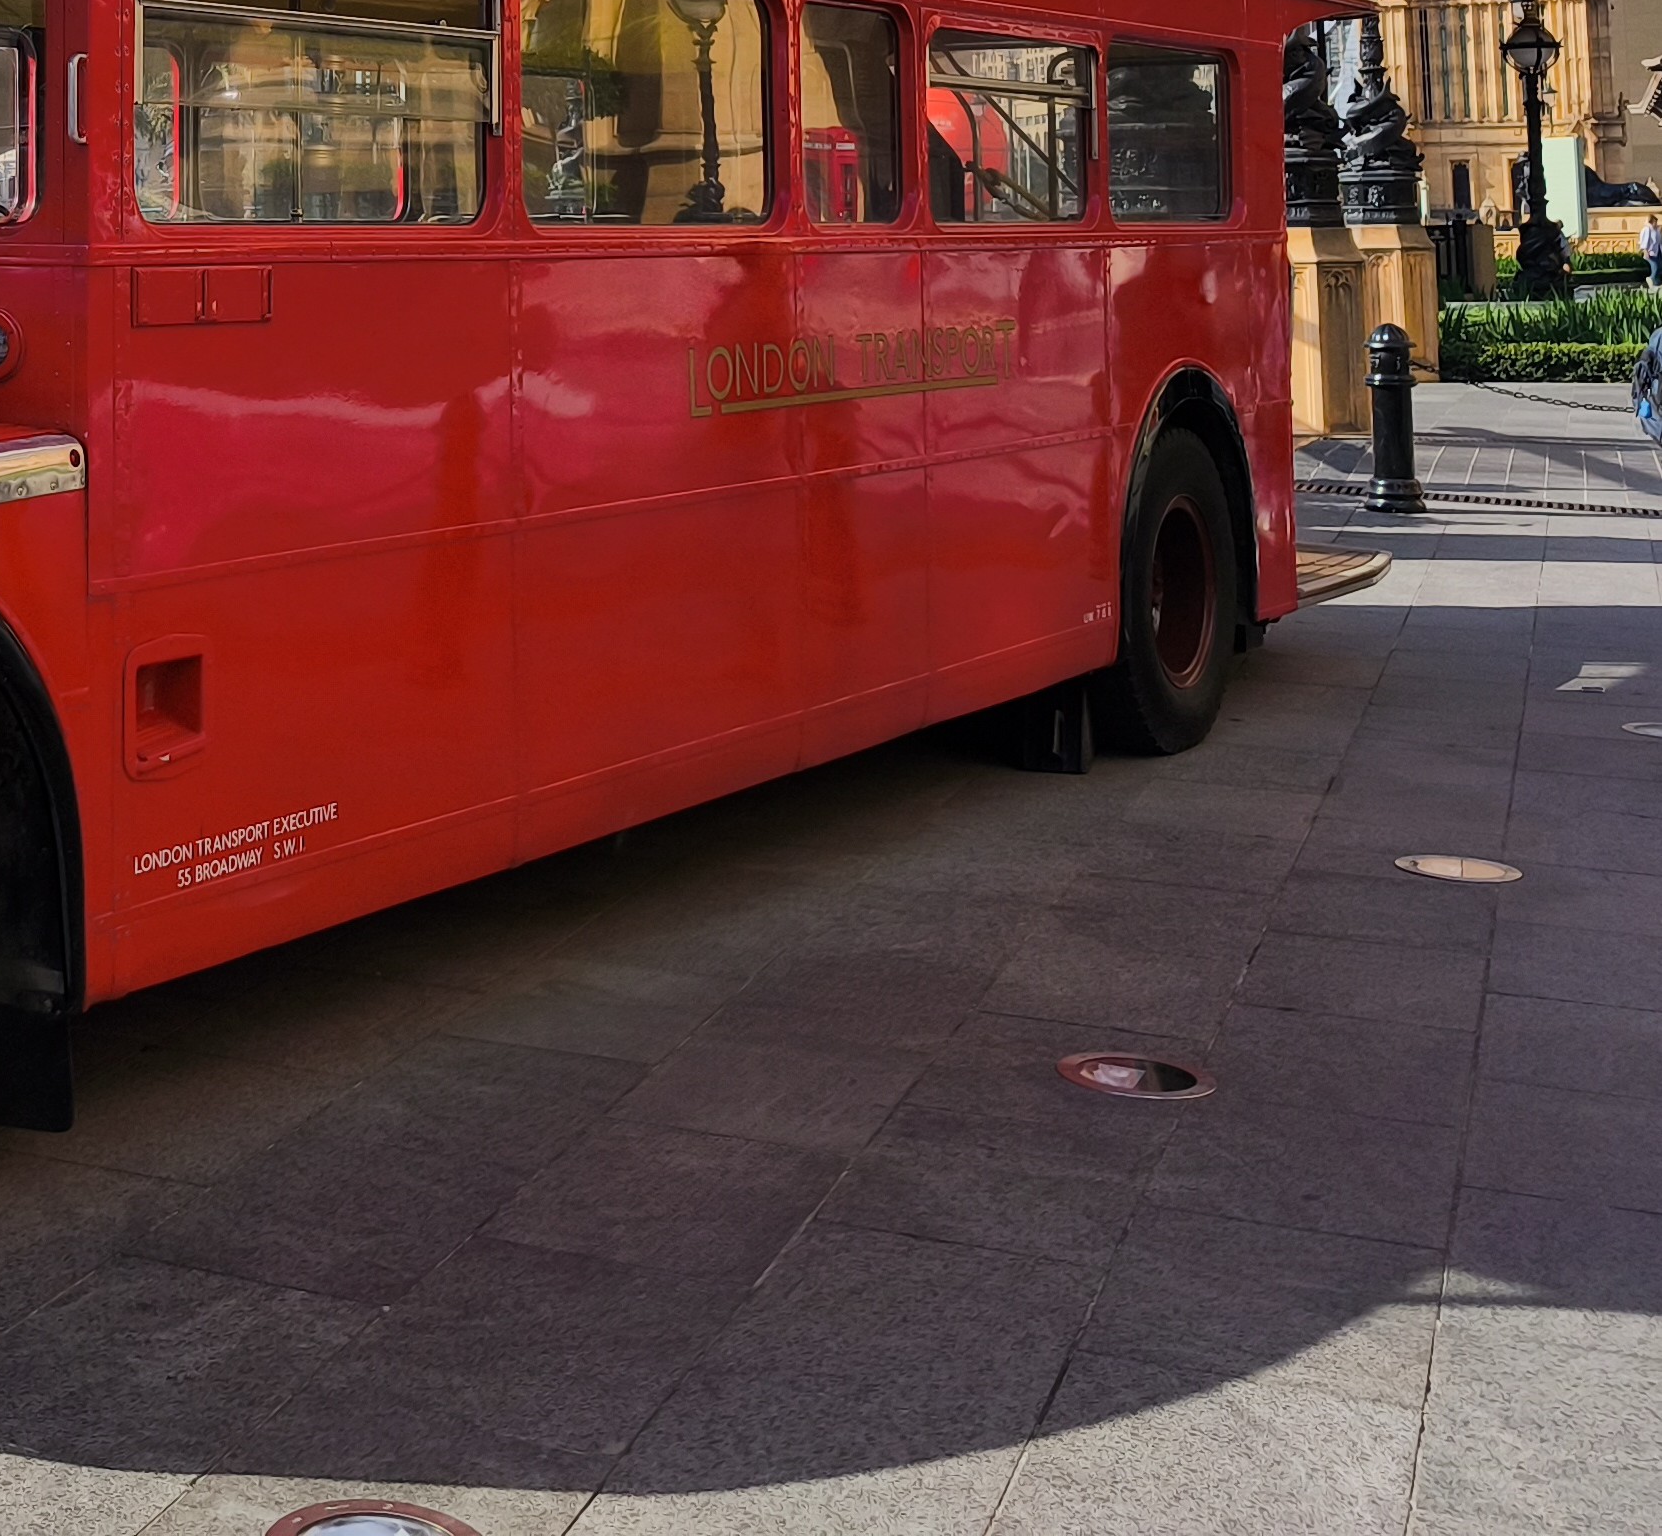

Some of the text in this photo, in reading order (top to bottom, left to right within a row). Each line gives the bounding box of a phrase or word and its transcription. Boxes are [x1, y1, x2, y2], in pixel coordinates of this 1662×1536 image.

[688, 319, 1016, 418] LONDON TRANSPORT
[134, 802, 338, 874] LONDON TRANSPORT EXECUTIVE
[177, 867, 192, 888] 55
[195, 847, 263, 883] BROADWAY
